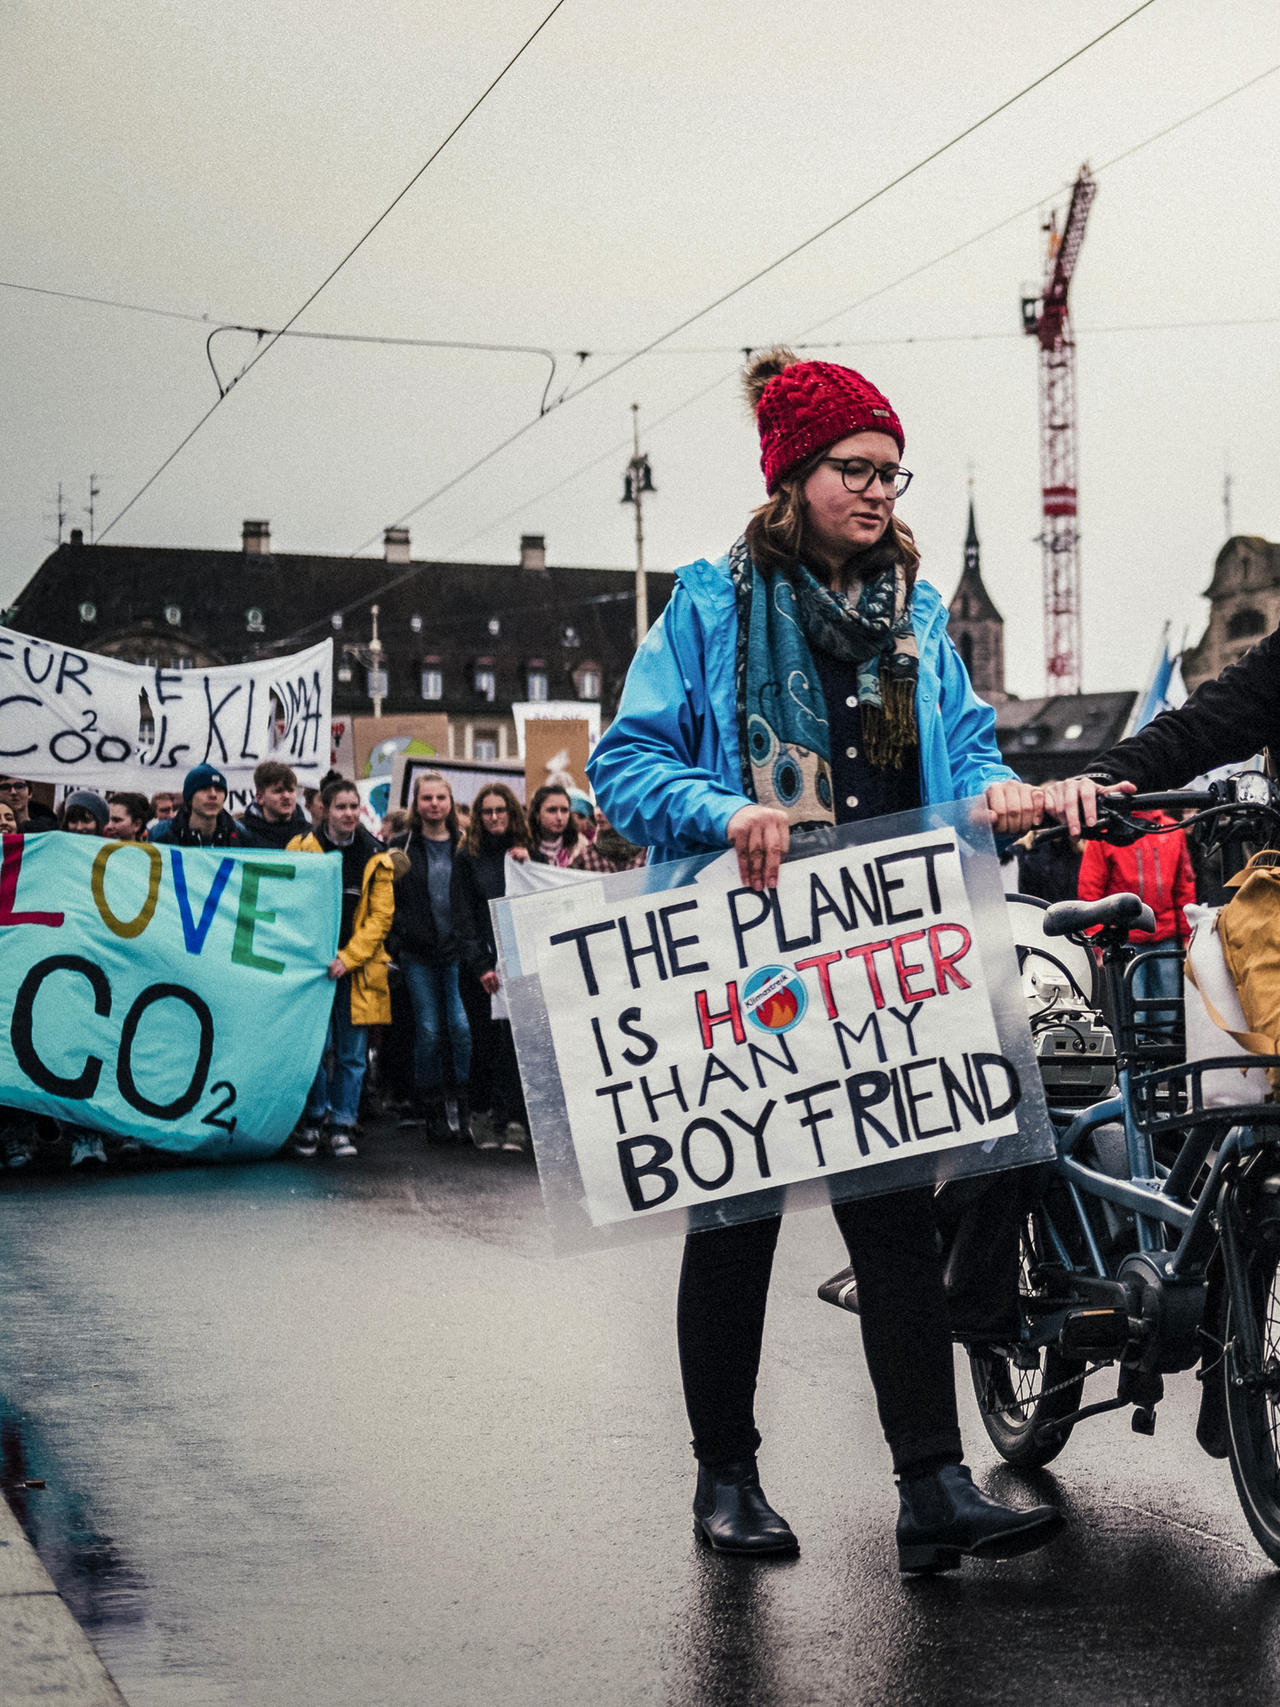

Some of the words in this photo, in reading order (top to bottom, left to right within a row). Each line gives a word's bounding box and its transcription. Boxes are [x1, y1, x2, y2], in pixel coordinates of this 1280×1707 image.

[0, 834, 296, 975] LOVE
[550, 900, 709, 996] THE
[727, 843, 955, 968] PLANET
[590, 1007, 658, 1077] IS
[596, 1034, 798, 1134] THAN
[832, 1001, 923, 1070] MY
[617, 1052, 1020, 1212] BOYFRIEND
